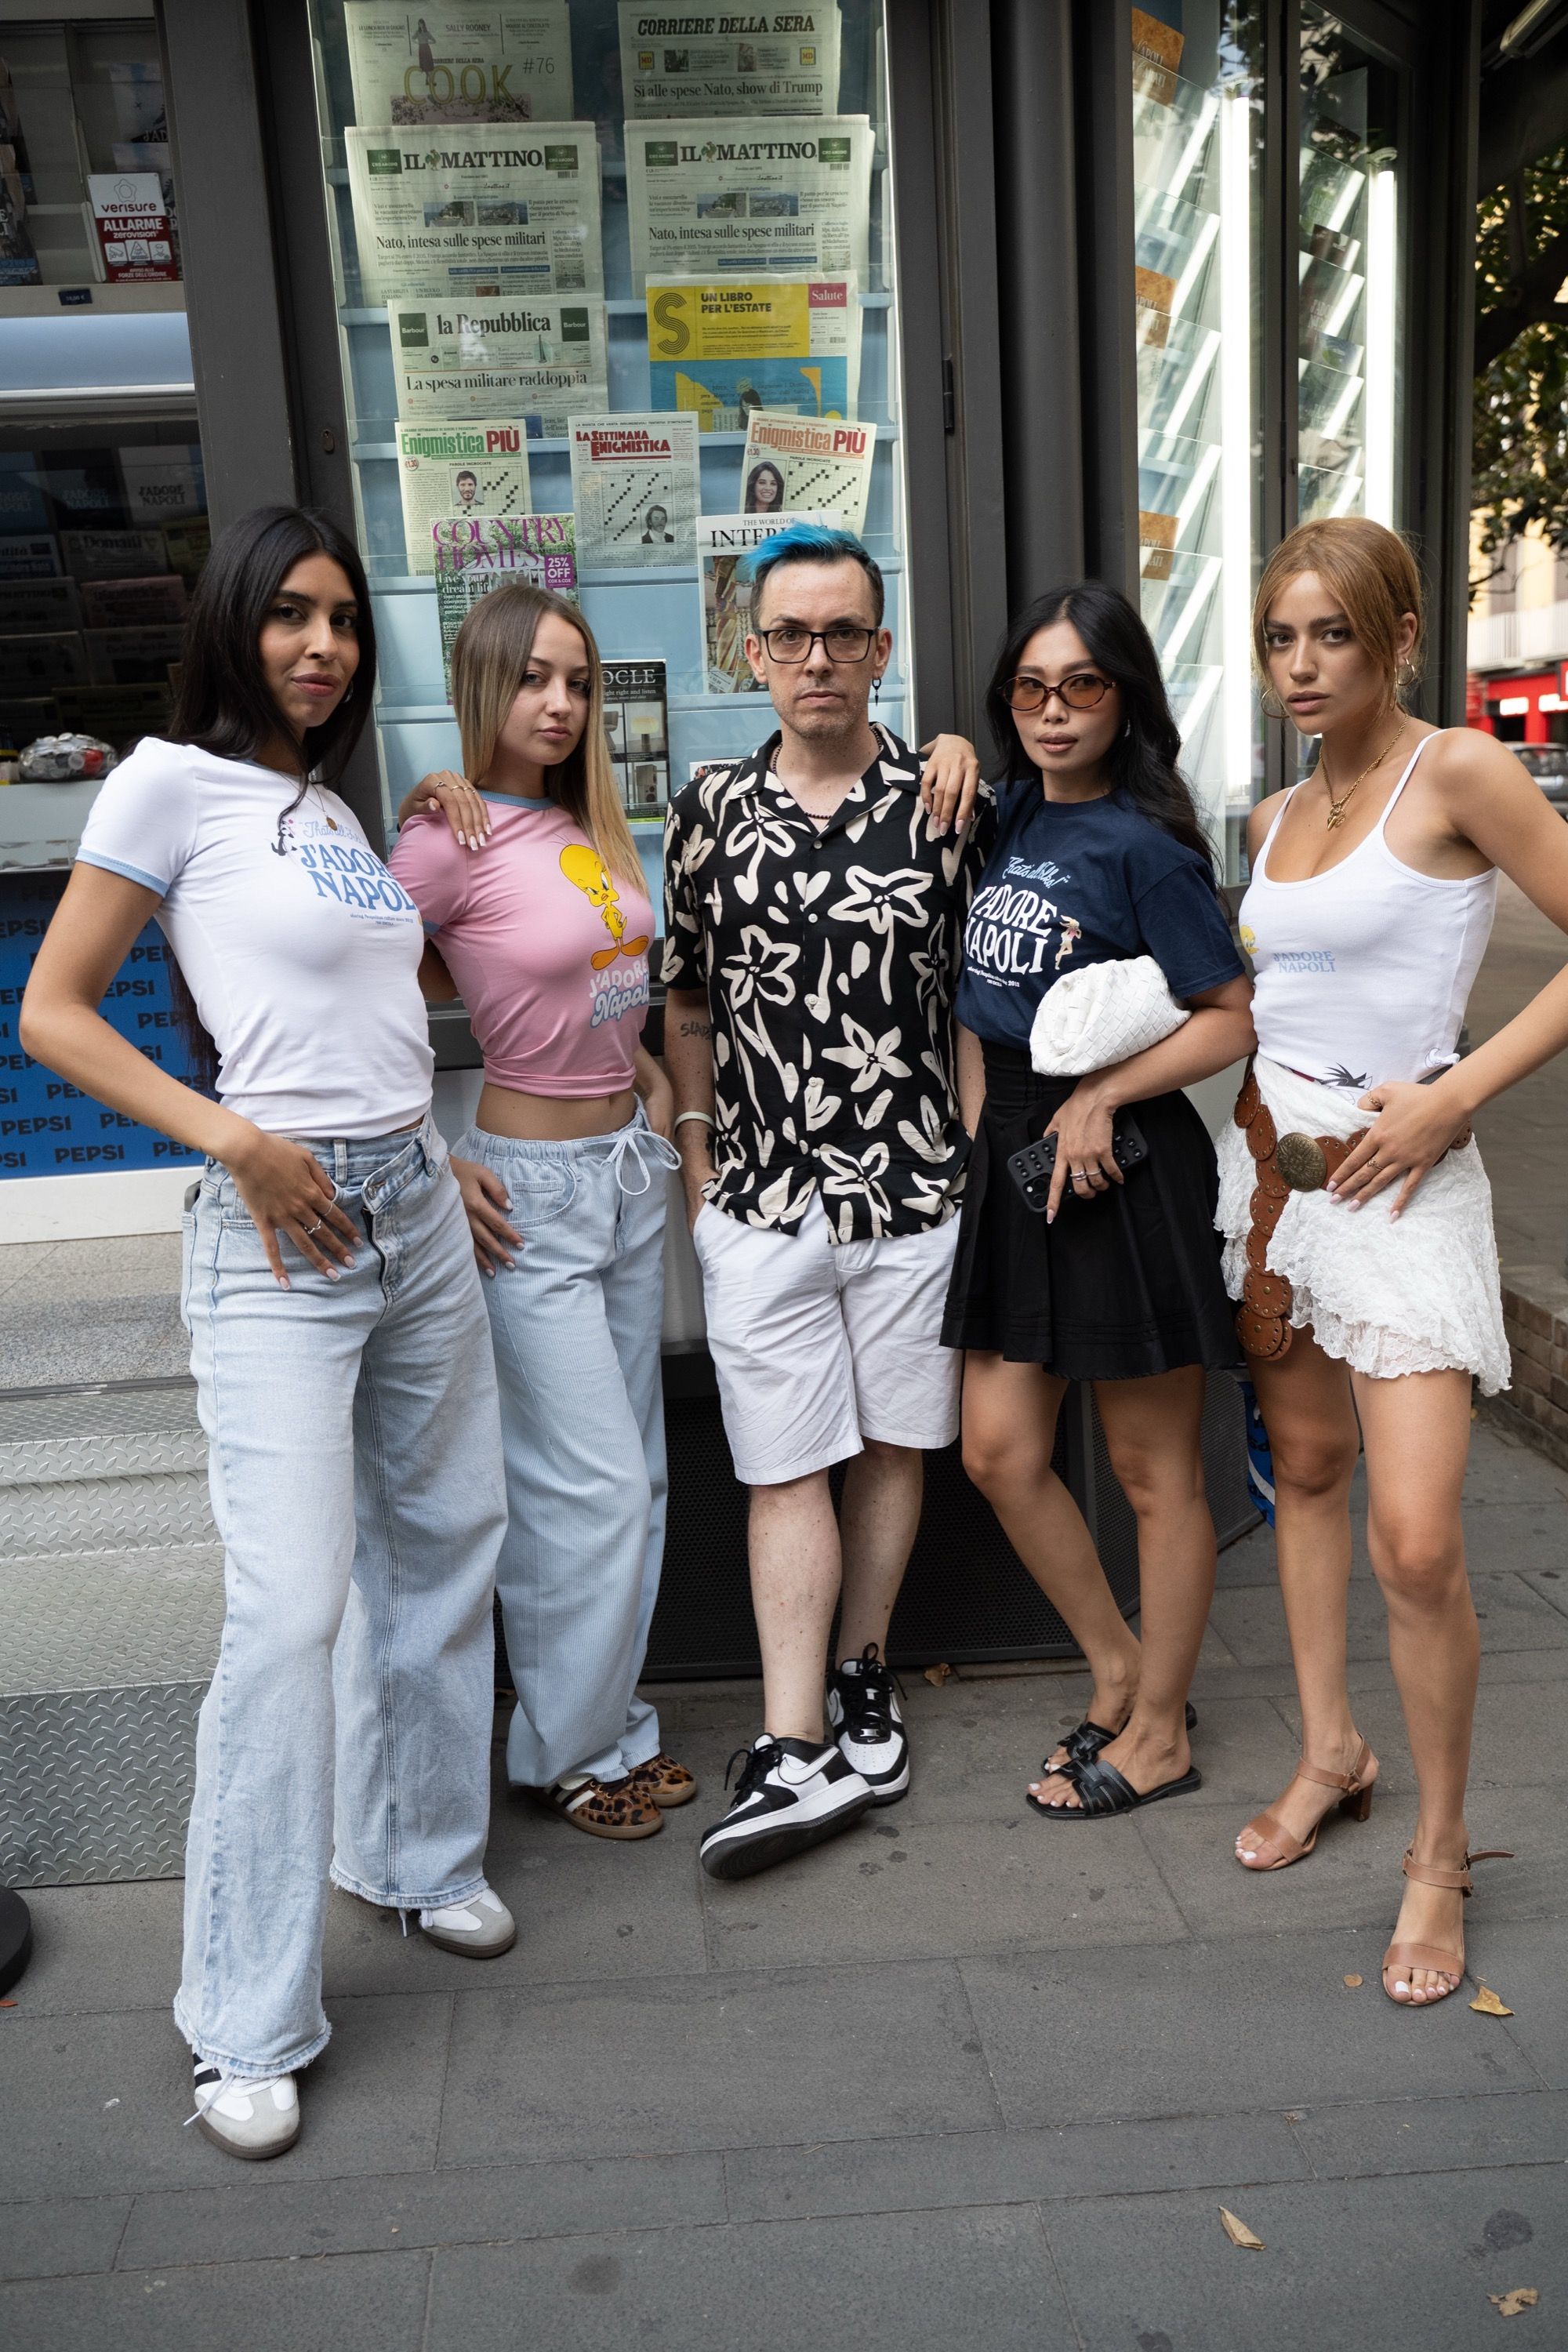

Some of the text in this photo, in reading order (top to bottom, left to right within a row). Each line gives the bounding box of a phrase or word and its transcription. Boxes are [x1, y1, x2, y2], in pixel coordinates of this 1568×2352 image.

[466, 24, 491, 32] ROONEY
[637, 16, 815, 36] CORRIERE DELLA SERA
[522, 57, 555, 74] #76
[404, 64, 514, 105] COOK
[648, 84, 668, 97] alle
[670, 86, 702, 100] spese
[704, 83, 735, 96] Nato,
[737, 82, 767, 94] show
[770, 82, 781, 93] di
[783, 82, 822, 96] Trump
[404, 150, 543, 170] IL MATTINO
[681, 142, 816, 162] IL MATTINO
[100, 202, 157, 213] verisure
[103, 218, 163, 231] ALLARME
[649, 227, 677, 240] Nato,
[680, 226, 712, 239] intesa
[714, 224, 740, 238] sulle
[742, 227, 771, 241] spese
[775, 223, 814, 237] militari
[376, 235, 405, 250] Nato,
[408, 234, 441, 249] intesa
[444, 233, 469, 247] sulle
[472, 235, 502, 249] spese
[505, 231, 546, 245] militari
[701, 292, 753, 303] UN LIBRO
[811, 290, 843, 301] Salute
[702, 303, 771, 314] PER L'ESTATE
[437, 312, 551, 337] la Repubblica
[406, 371, 587, 393] La spesa militare raddoppia
[401, 432, 485, 458] Enigmistica
[486, 426, 520, 453] PIÙ
[576, 430, 649, 441] LA SETTIMANA
[750, 422, 831, 451] Enigmistica
[833, 428, 866, 454] PIÙ
[590, 439, 671, 457] ENIGMISTICA
[143, 495, 186, 506] NAPOLI
[433, 517, 567, 546] COUNTRY
[437, 544, 540, 570] HOMES
[548, 557, 569, 568] 25%
[438, 573, 460, 583] Live
[548, 568, 571, 578] OFF
[602, 669, 656, 685] OCLE
[299, 844, 396, 880] J'ADOR
[307, 870, 417, 912] NAPOL
[964, 916, 1049, 975] NAPOLI
[1273, 951, 1336, 962] J'ADORE
[589, 955, 648, 998] J'ADORE
[1279, 962, 1337, 974] NAPOLI
[590, 974, 649, 1029] Napoli
[2, 1115, 72, 1136] PEPSI
[55, 1144, 125, 1163] PEPSI
